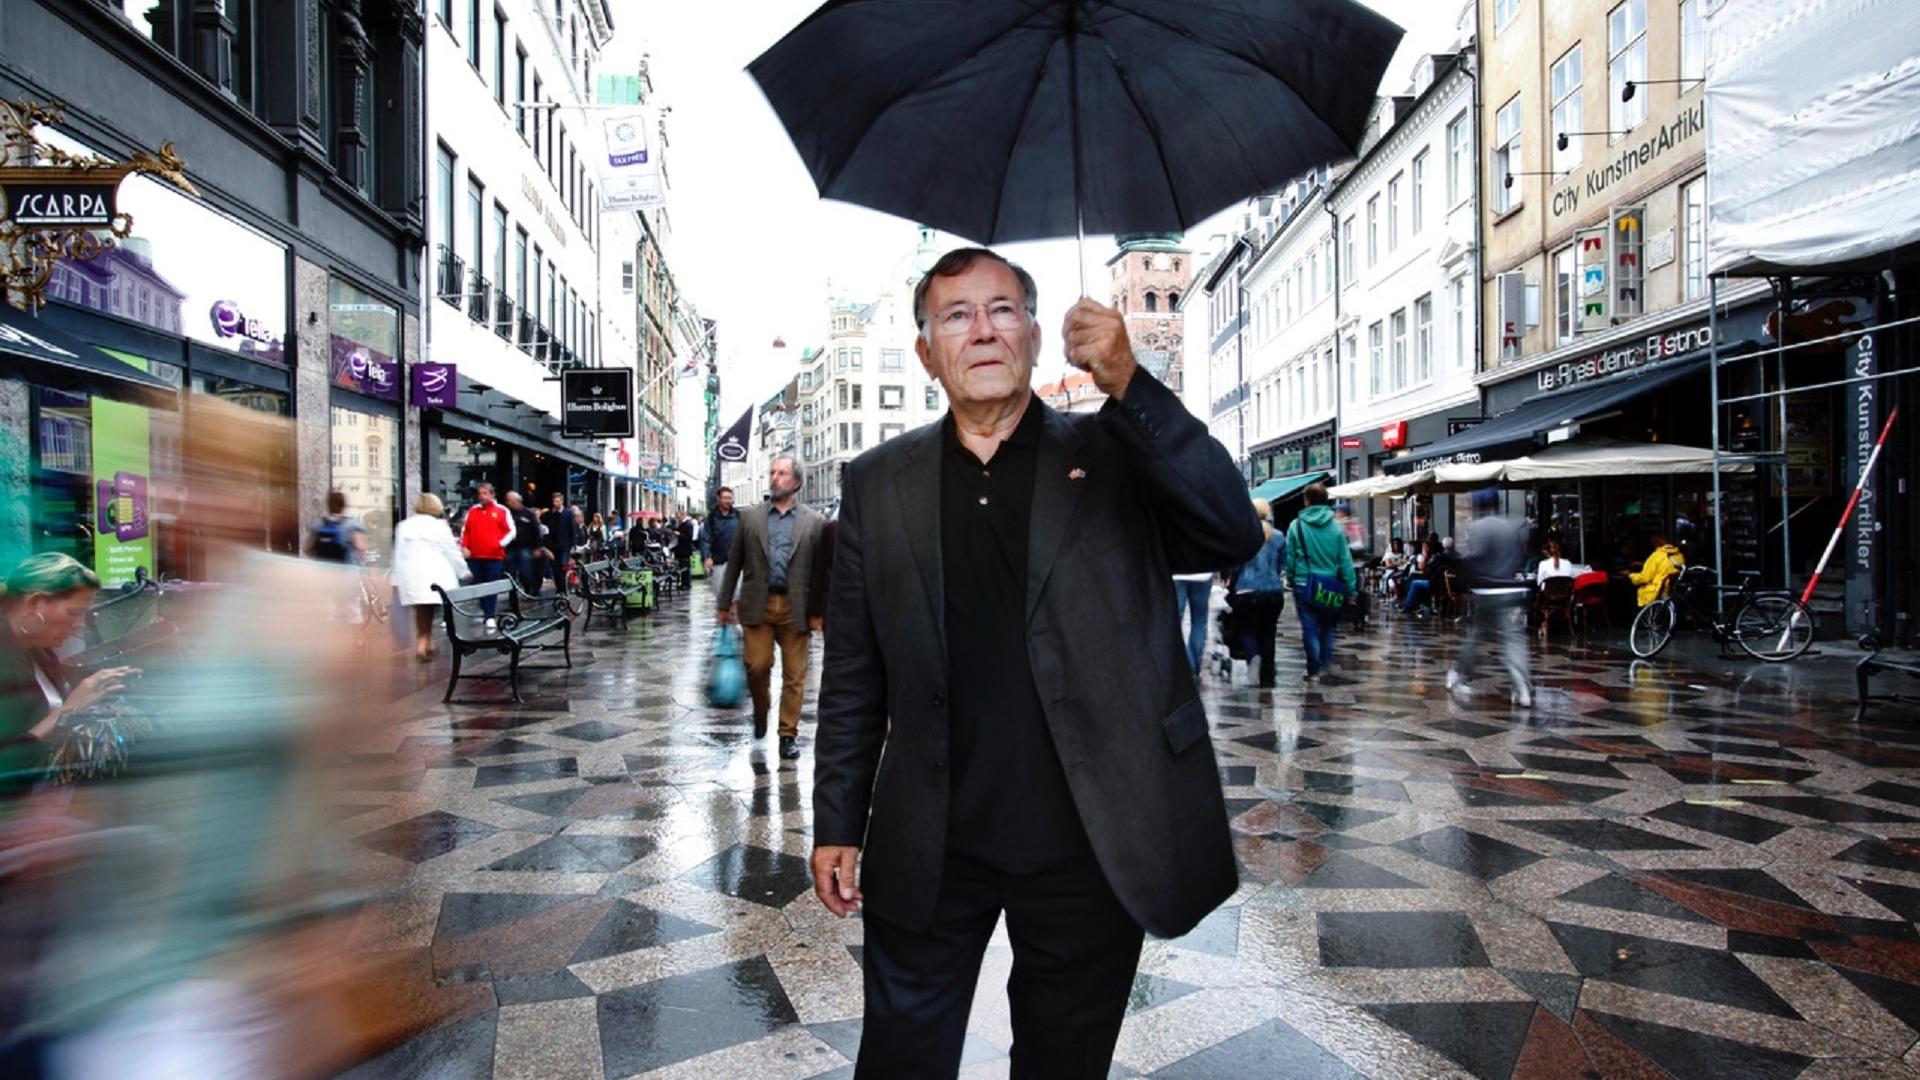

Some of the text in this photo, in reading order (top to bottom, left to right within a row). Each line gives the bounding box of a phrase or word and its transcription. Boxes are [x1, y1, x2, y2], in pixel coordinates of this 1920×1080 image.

[613, 153, 644, 164] TAX FREE
[16, 194, 107, 216] SCARPA
[1552, 185, 1579, 217] City
[1538, 370, 1554, 391] Le
[1646, 326, 1712, 361] Bistro
[1855, 335, 1873, 378] City
